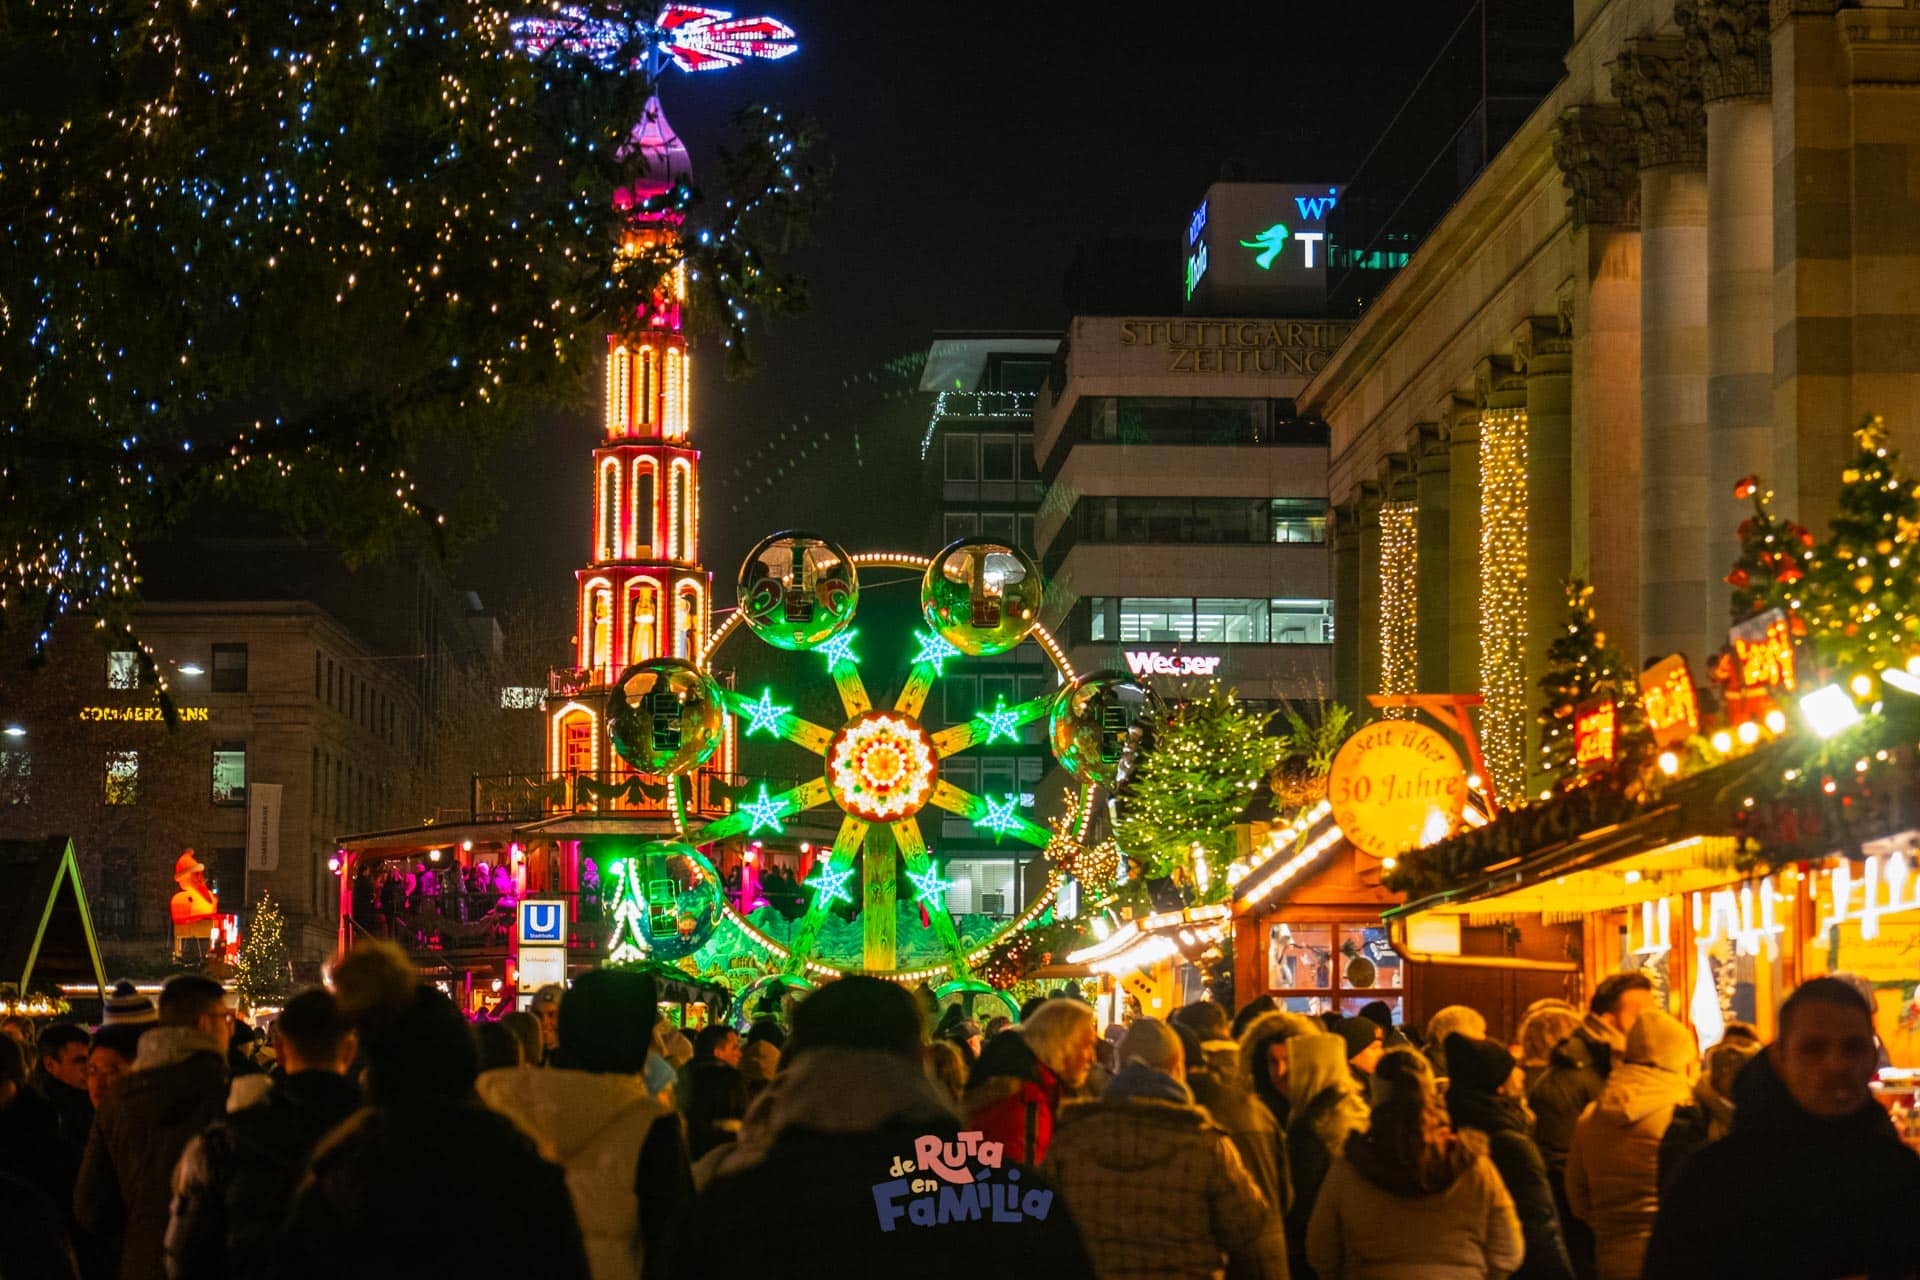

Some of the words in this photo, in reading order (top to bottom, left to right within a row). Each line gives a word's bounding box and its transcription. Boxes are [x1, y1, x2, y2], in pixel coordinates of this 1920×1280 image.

[80, 707, 209, 721] COMMERZANK
[1335, 776, 1372, 804] 30
[529, 905, 556, 932] U
